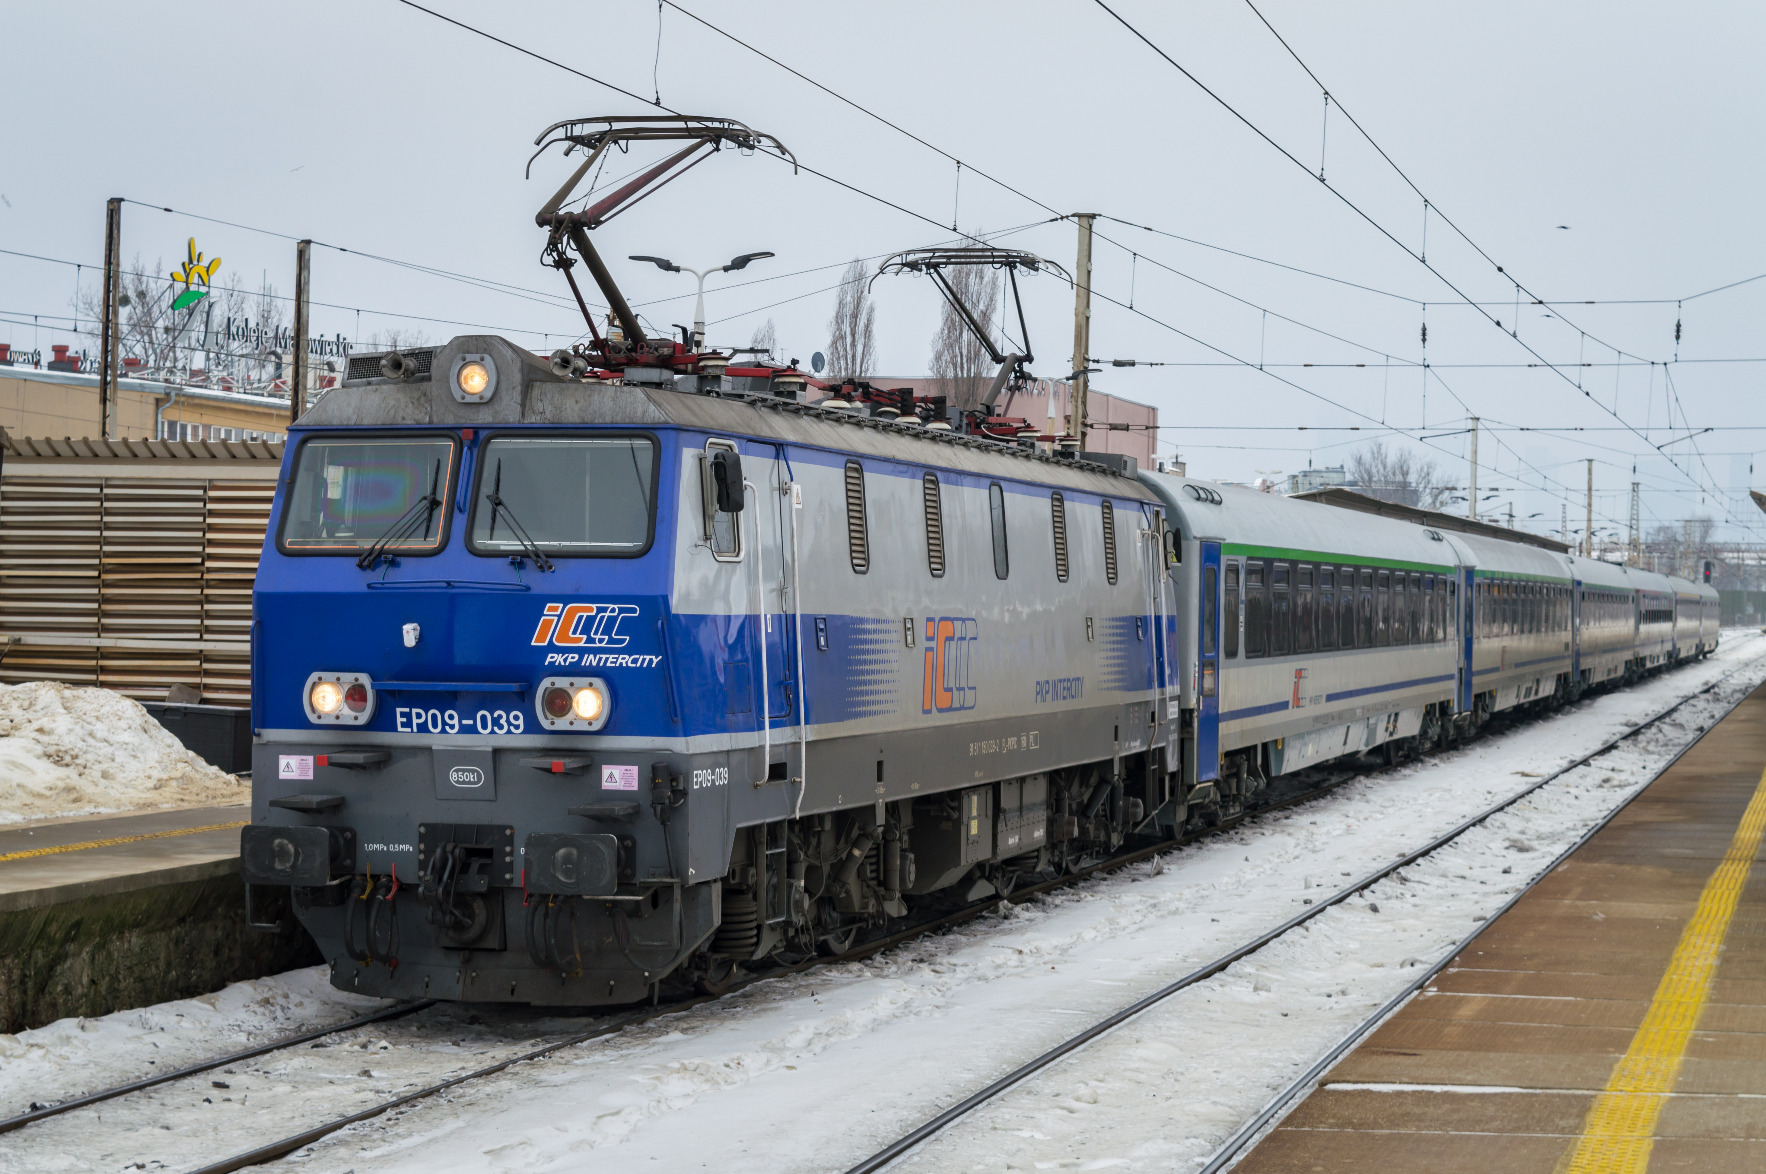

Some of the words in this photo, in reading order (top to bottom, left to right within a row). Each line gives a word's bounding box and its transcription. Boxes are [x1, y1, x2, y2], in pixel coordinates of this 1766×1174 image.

[227, 316, 268, 350] Koleje
[274, 324, 353, 358] Mawieckie
[545, 653, 579, 666] PKP
[581, 653, 662, 668] INTERCITY
[1035, 680, 1050, 704] PKP
[1051, 676, 1085, 701] INTERCITY
[395, 707, 525, 735] EP09-039
[693, 767, 729, 789] EP09-039
